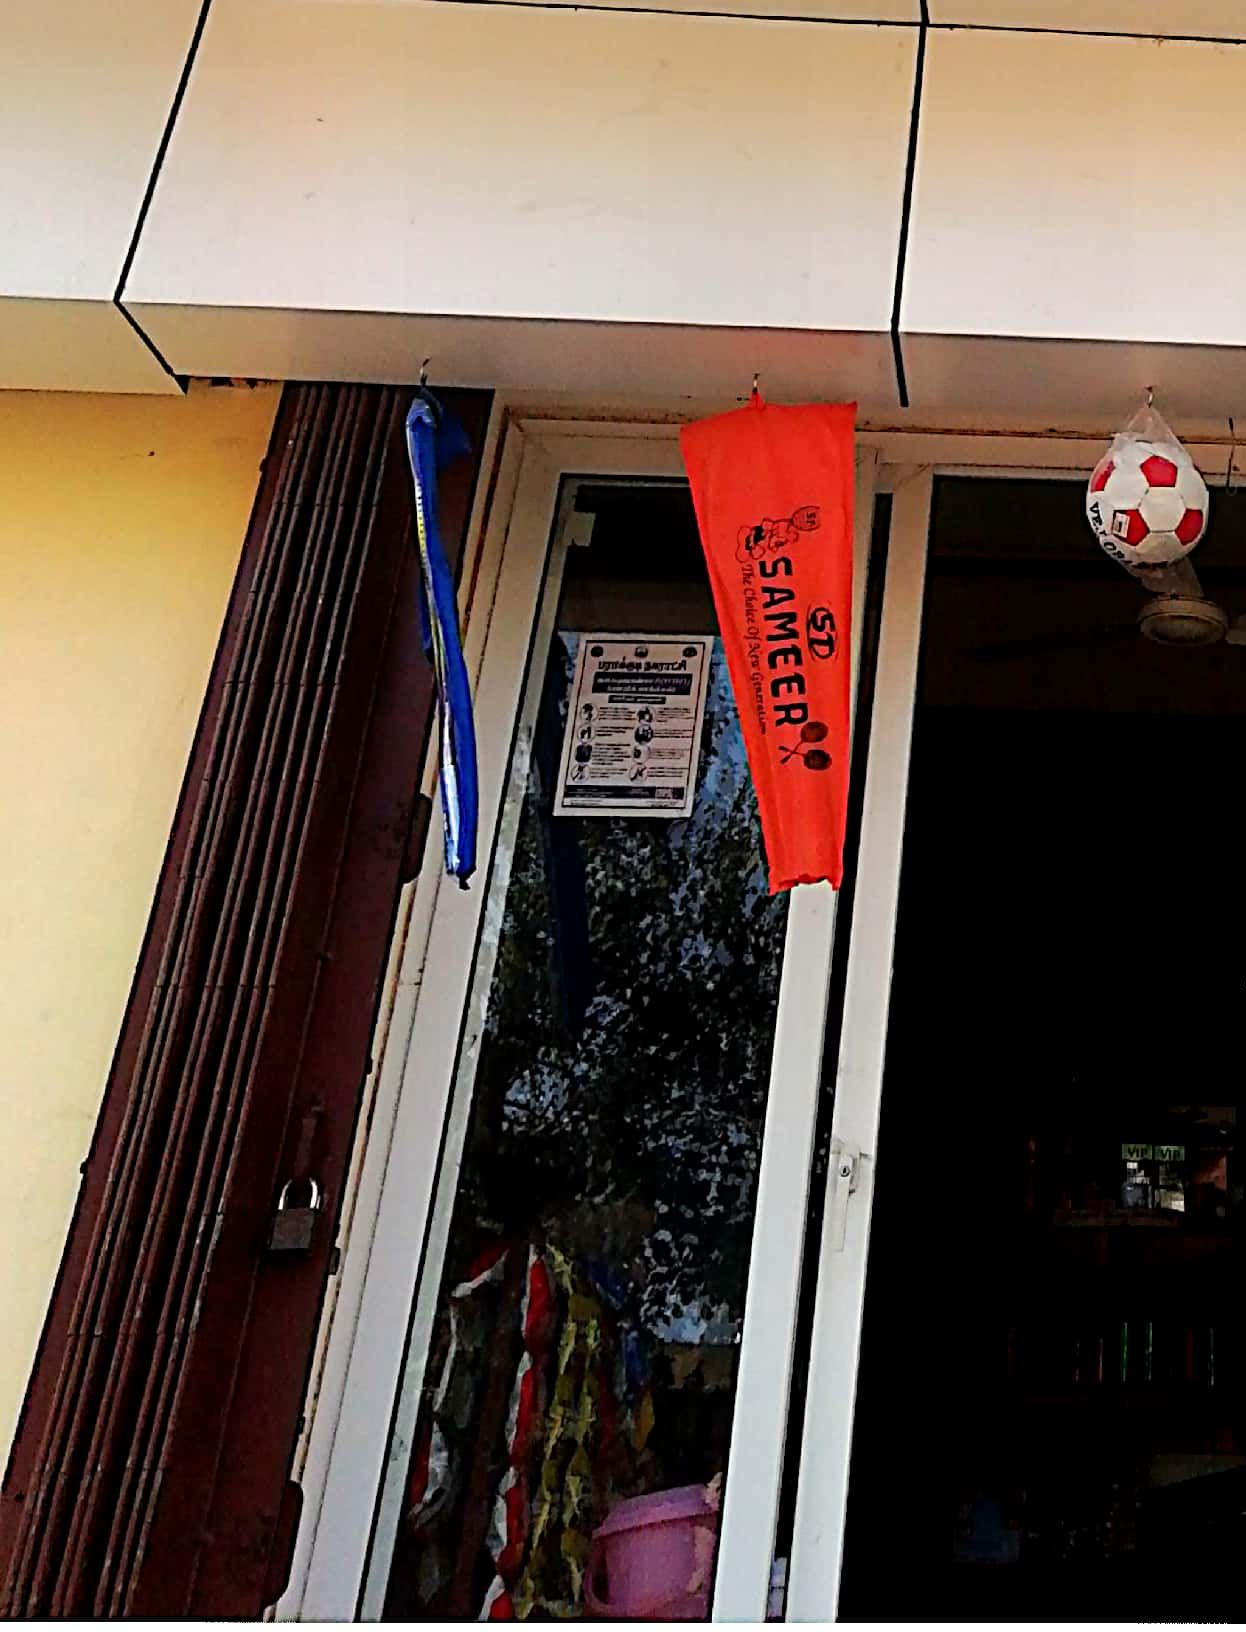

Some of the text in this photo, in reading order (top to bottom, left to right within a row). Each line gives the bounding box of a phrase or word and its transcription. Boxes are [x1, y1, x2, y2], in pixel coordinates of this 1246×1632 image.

[741, 563, 755, 585] The
[743, 587, 759, 625] Choice
[744, 625, 761, 641] Of
[758, 556, 809, 727] SAMEER
[748, 642, 762, 669] New
